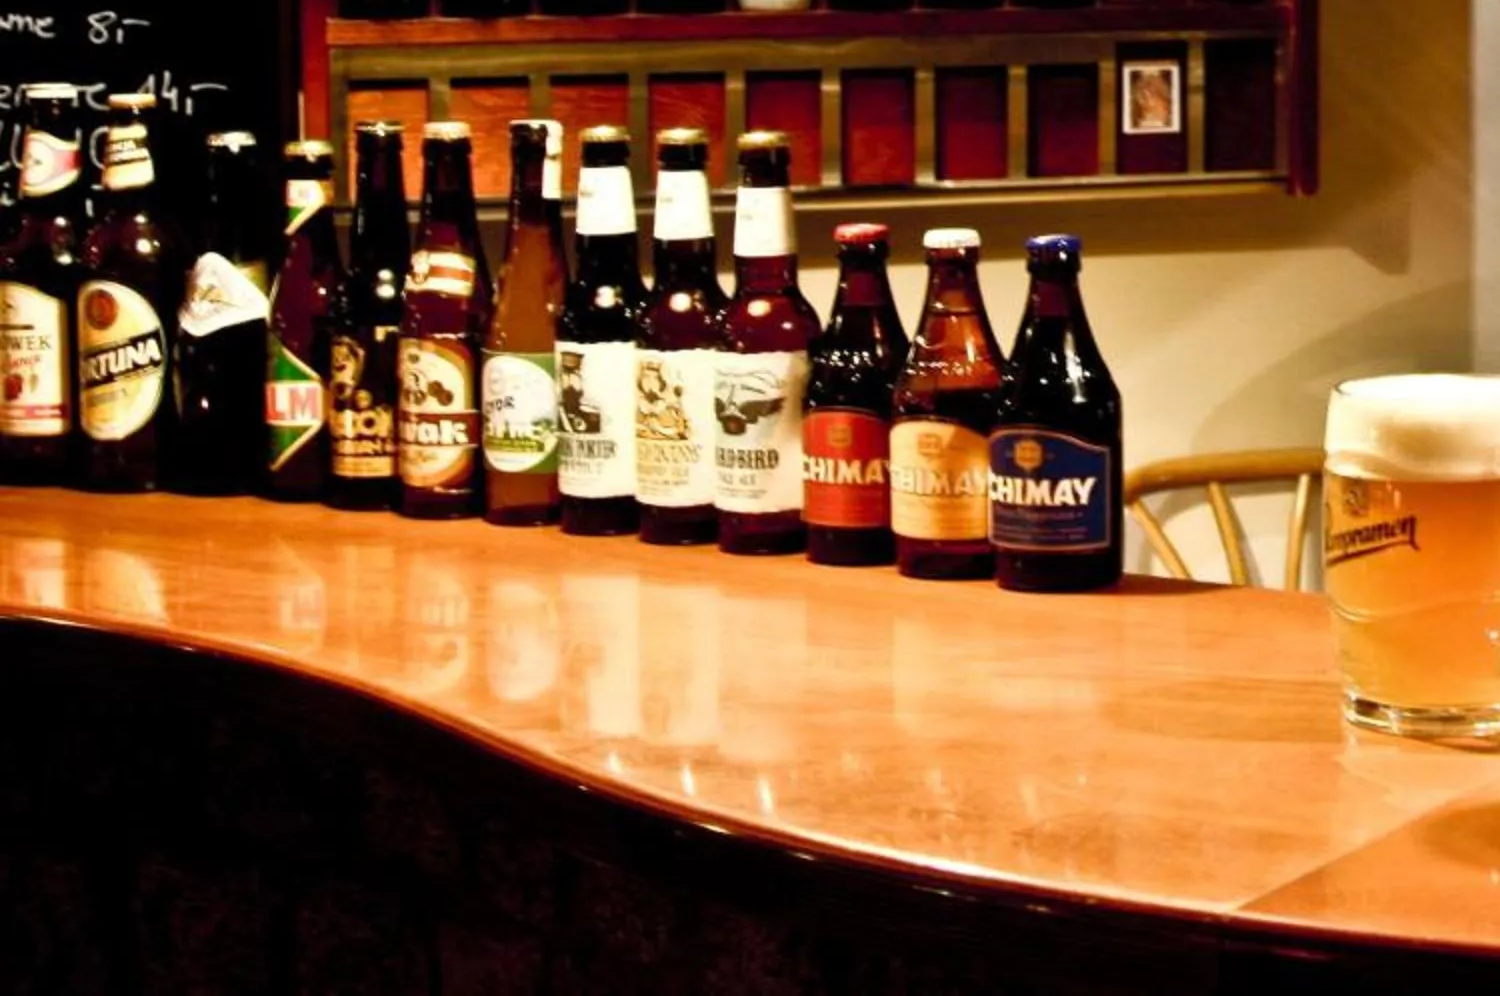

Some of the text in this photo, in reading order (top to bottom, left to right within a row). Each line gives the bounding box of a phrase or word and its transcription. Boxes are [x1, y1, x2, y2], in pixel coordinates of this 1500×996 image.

[82, 338, 162, 380] RTUNA
[266, 383, 319, 421] LM
[988, 468, 1097, 506] CHIMAY
